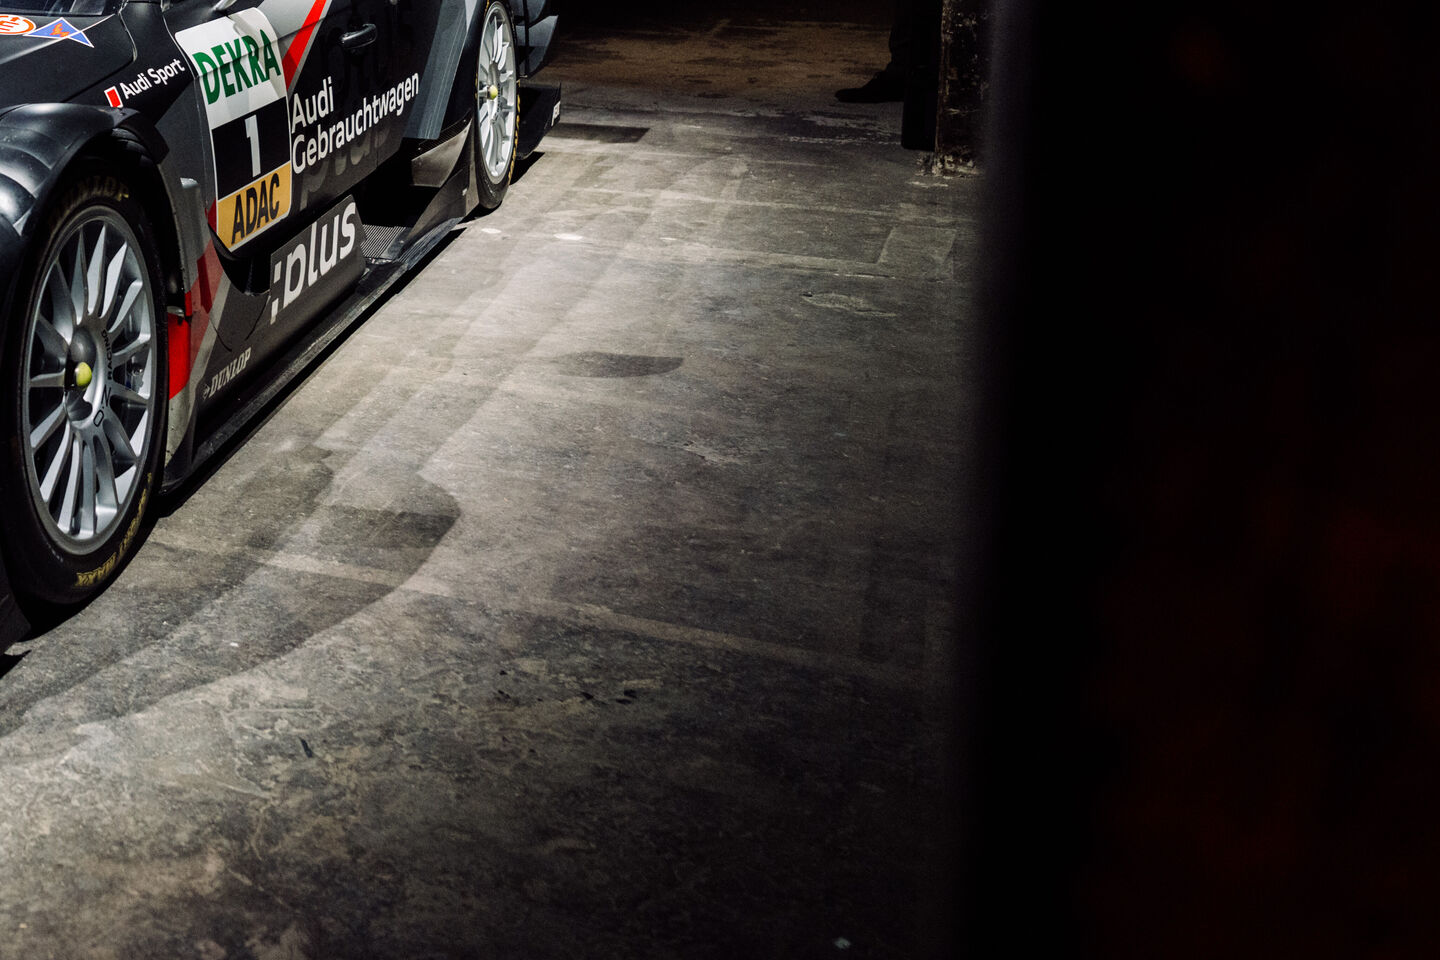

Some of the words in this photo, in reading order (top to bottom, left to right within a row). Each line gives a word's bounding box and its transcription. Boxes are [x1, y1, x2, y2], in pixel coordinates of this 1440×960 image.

[120, 72, 153, 100] Audi
[147, 58, 186, 85] Sport
[192, 29, 281, 105] DEKRA
[291, 76, 334, 134] Audi
[292, 72, 419, 174] Gebrauchtwagen
[244, 114, 261, 178] 1
[231, 172, 280, 245] ADAC
[208, 347, 251, 398] DUNLOP
